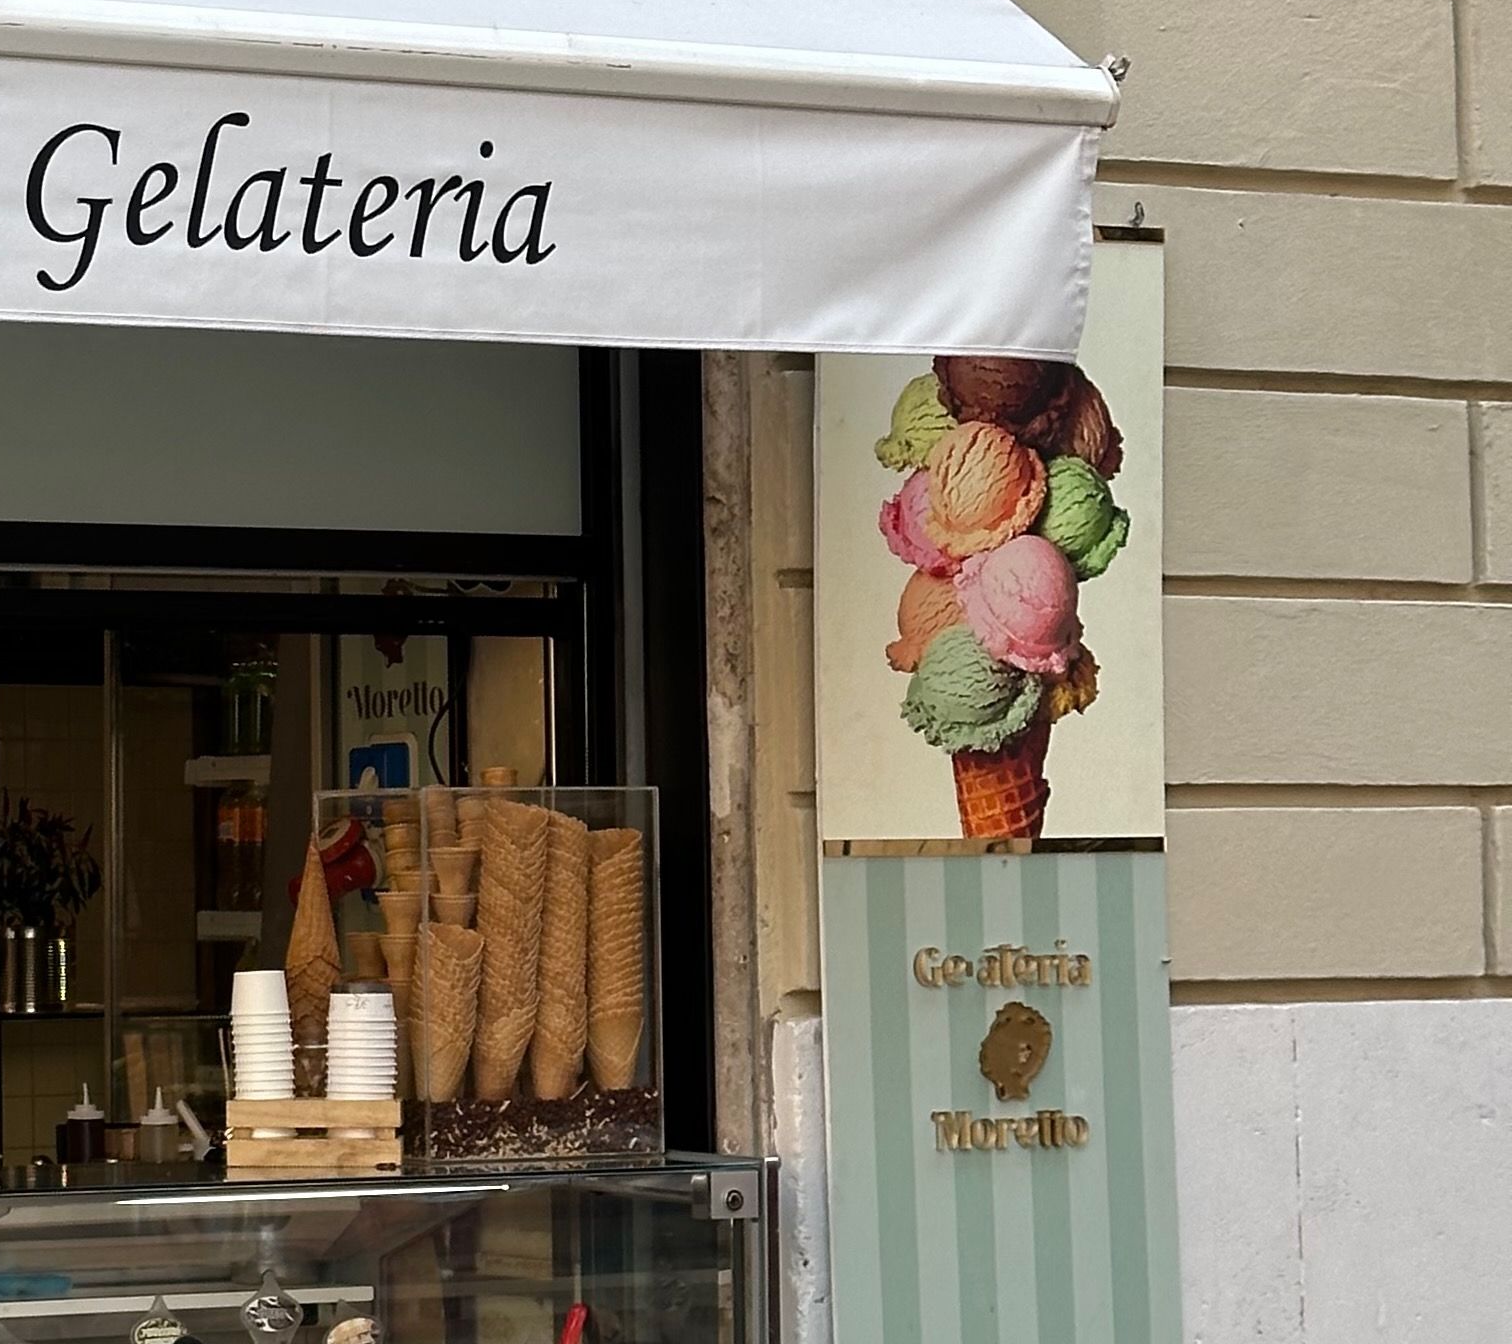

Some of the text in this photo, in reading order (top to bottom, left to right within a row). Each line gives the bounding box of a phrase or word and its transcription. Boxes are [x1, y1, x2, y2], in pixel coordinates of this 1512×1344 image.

[25, 112, 556, 291] Gelateria
[913, 939, 1092, 990] Geateria
[931, 1110, 1091, 1152] Moretto
